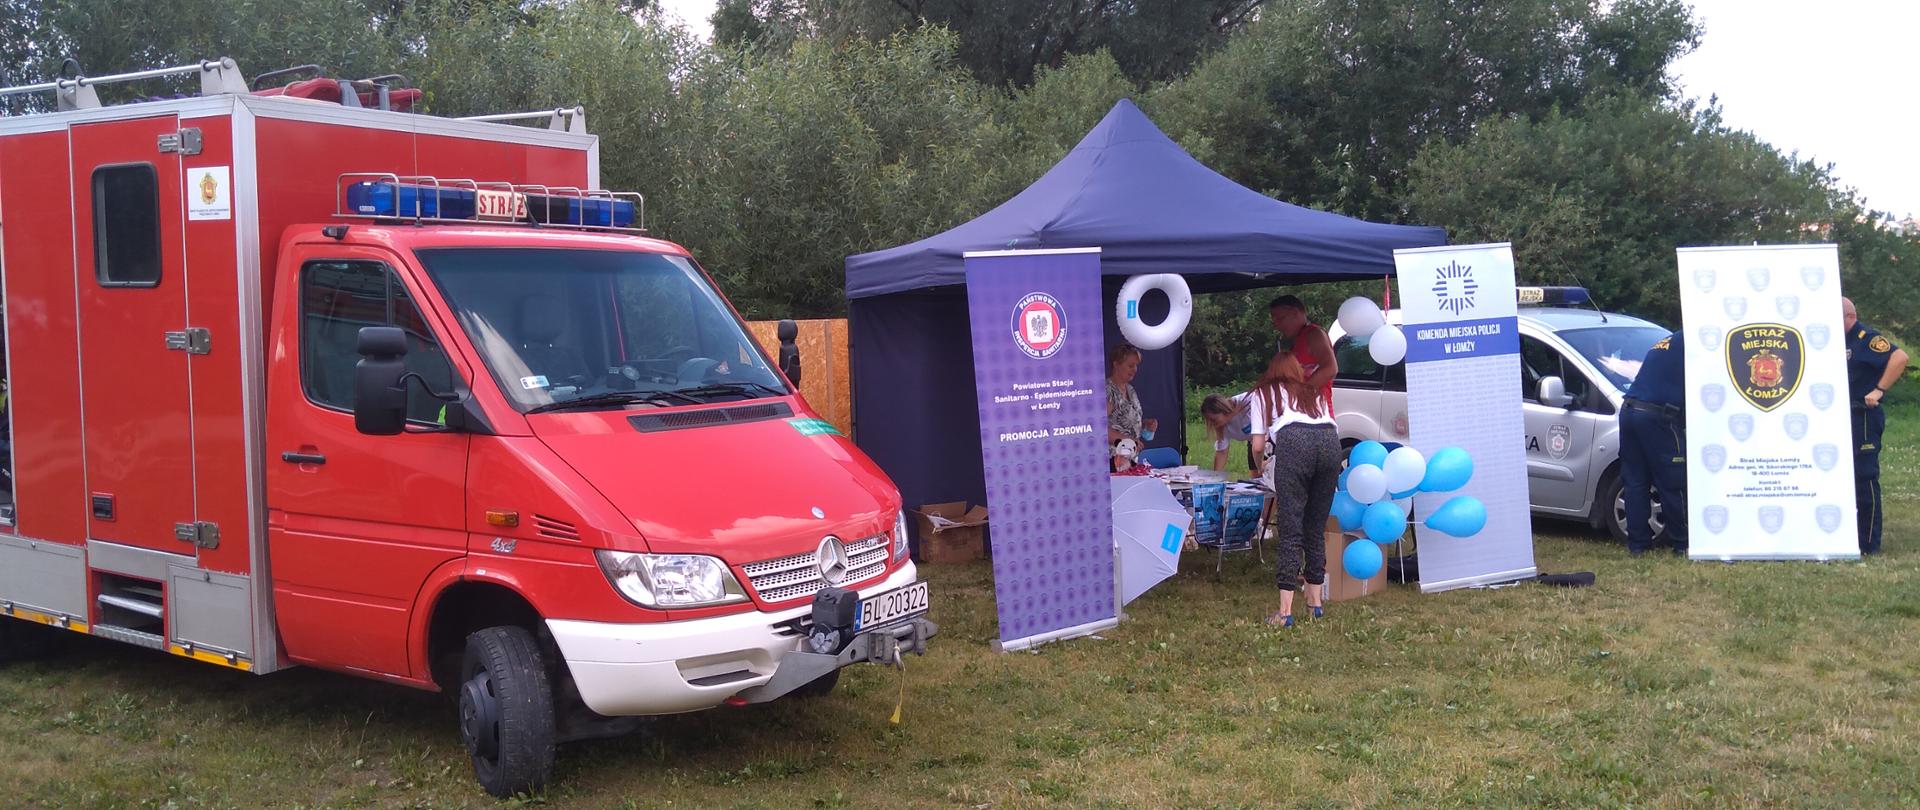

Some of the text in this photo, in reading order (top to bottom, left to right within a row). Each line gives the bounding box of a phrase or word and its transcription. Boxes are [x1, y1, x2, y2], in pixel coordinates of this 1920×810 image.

[1019, 294, 1056, 310] PAŃSTWOWA
[1417, 323, 1500, 340] KOMENDA MIEJSKA POLICJI
[1444, 340, 1475, 353] W ŁOMŻY
[1741, 339, 1788, 350] MIEJSKA
[1013, 379, 1073, 390] Powiatowa Stacja
[1745, 386, 1788, 398] ŁOMŻA
[994, 395, 1029, 403] Sanitarno
[1034, 388, 1092, 400] Epidemiologiczna
[1039, 402, 1060, 410] Łomży
[1000, 424, 1092, 442] PROMOCJA ZDROWIA
[490, 536, 517, 553] 4x4
[863, 585, 926, 624] BL 20322
